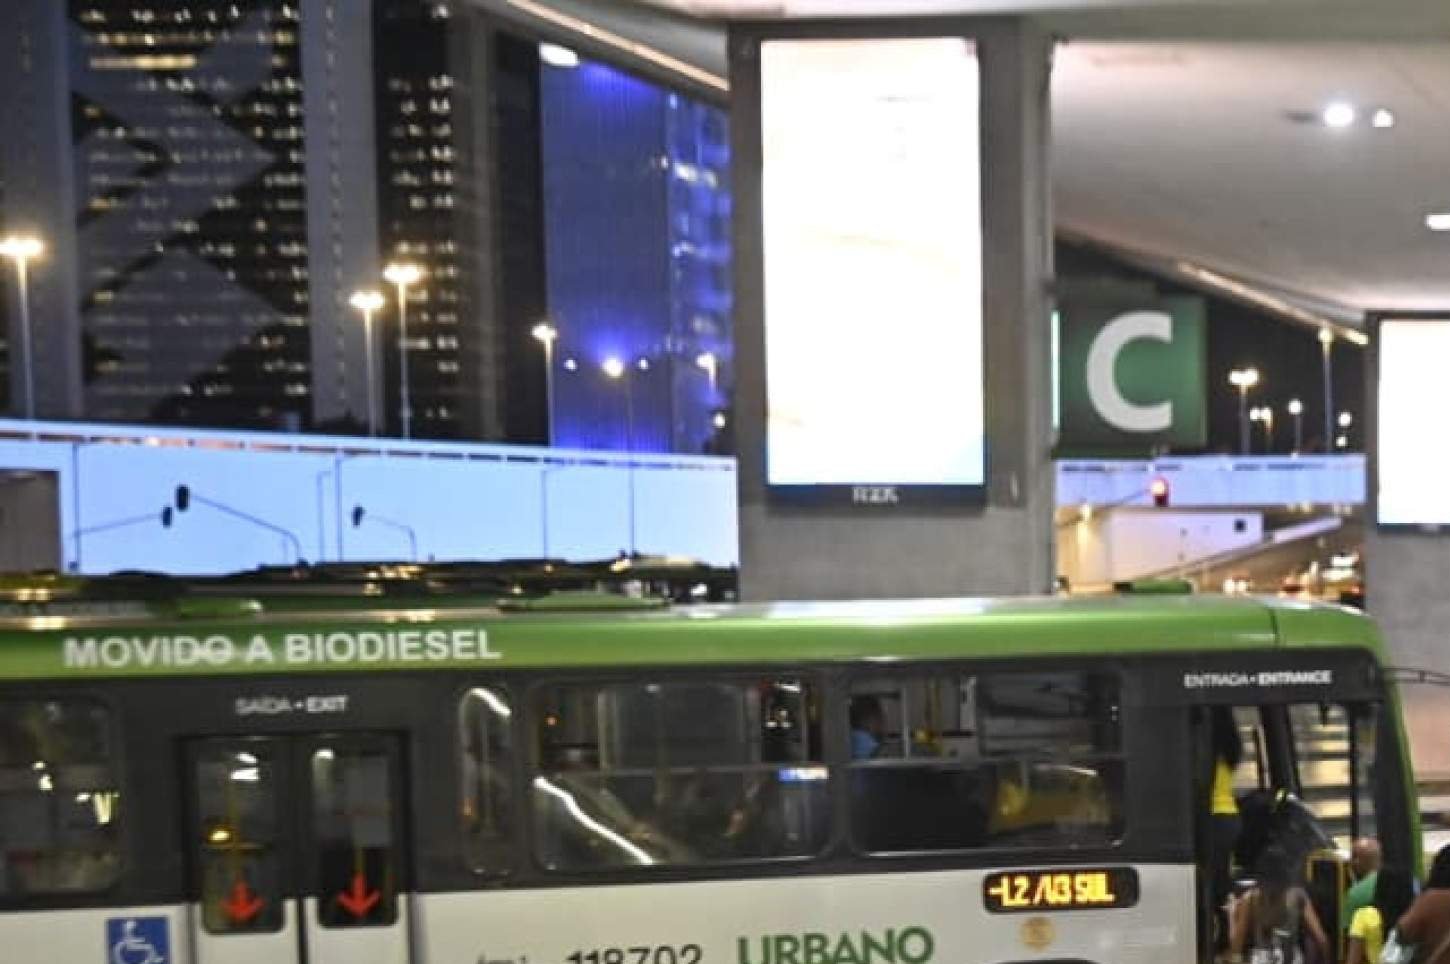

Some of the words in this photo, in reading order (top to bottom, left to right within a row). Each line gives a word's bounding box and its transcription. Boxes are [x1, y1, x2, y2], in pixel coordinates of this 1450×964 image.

[1087, 309, 1173, 432] C
[63, 634, 235, 668] MOVIDO
[246, 634, 274, 663] A
[285, 629, 501, 663] BIODIESEL
[1184, 673, 1250, 688] ENTRADA
[1258, 669, 1333, 686] ENTRANCE
[306, 694, 347, 713] EXIT
